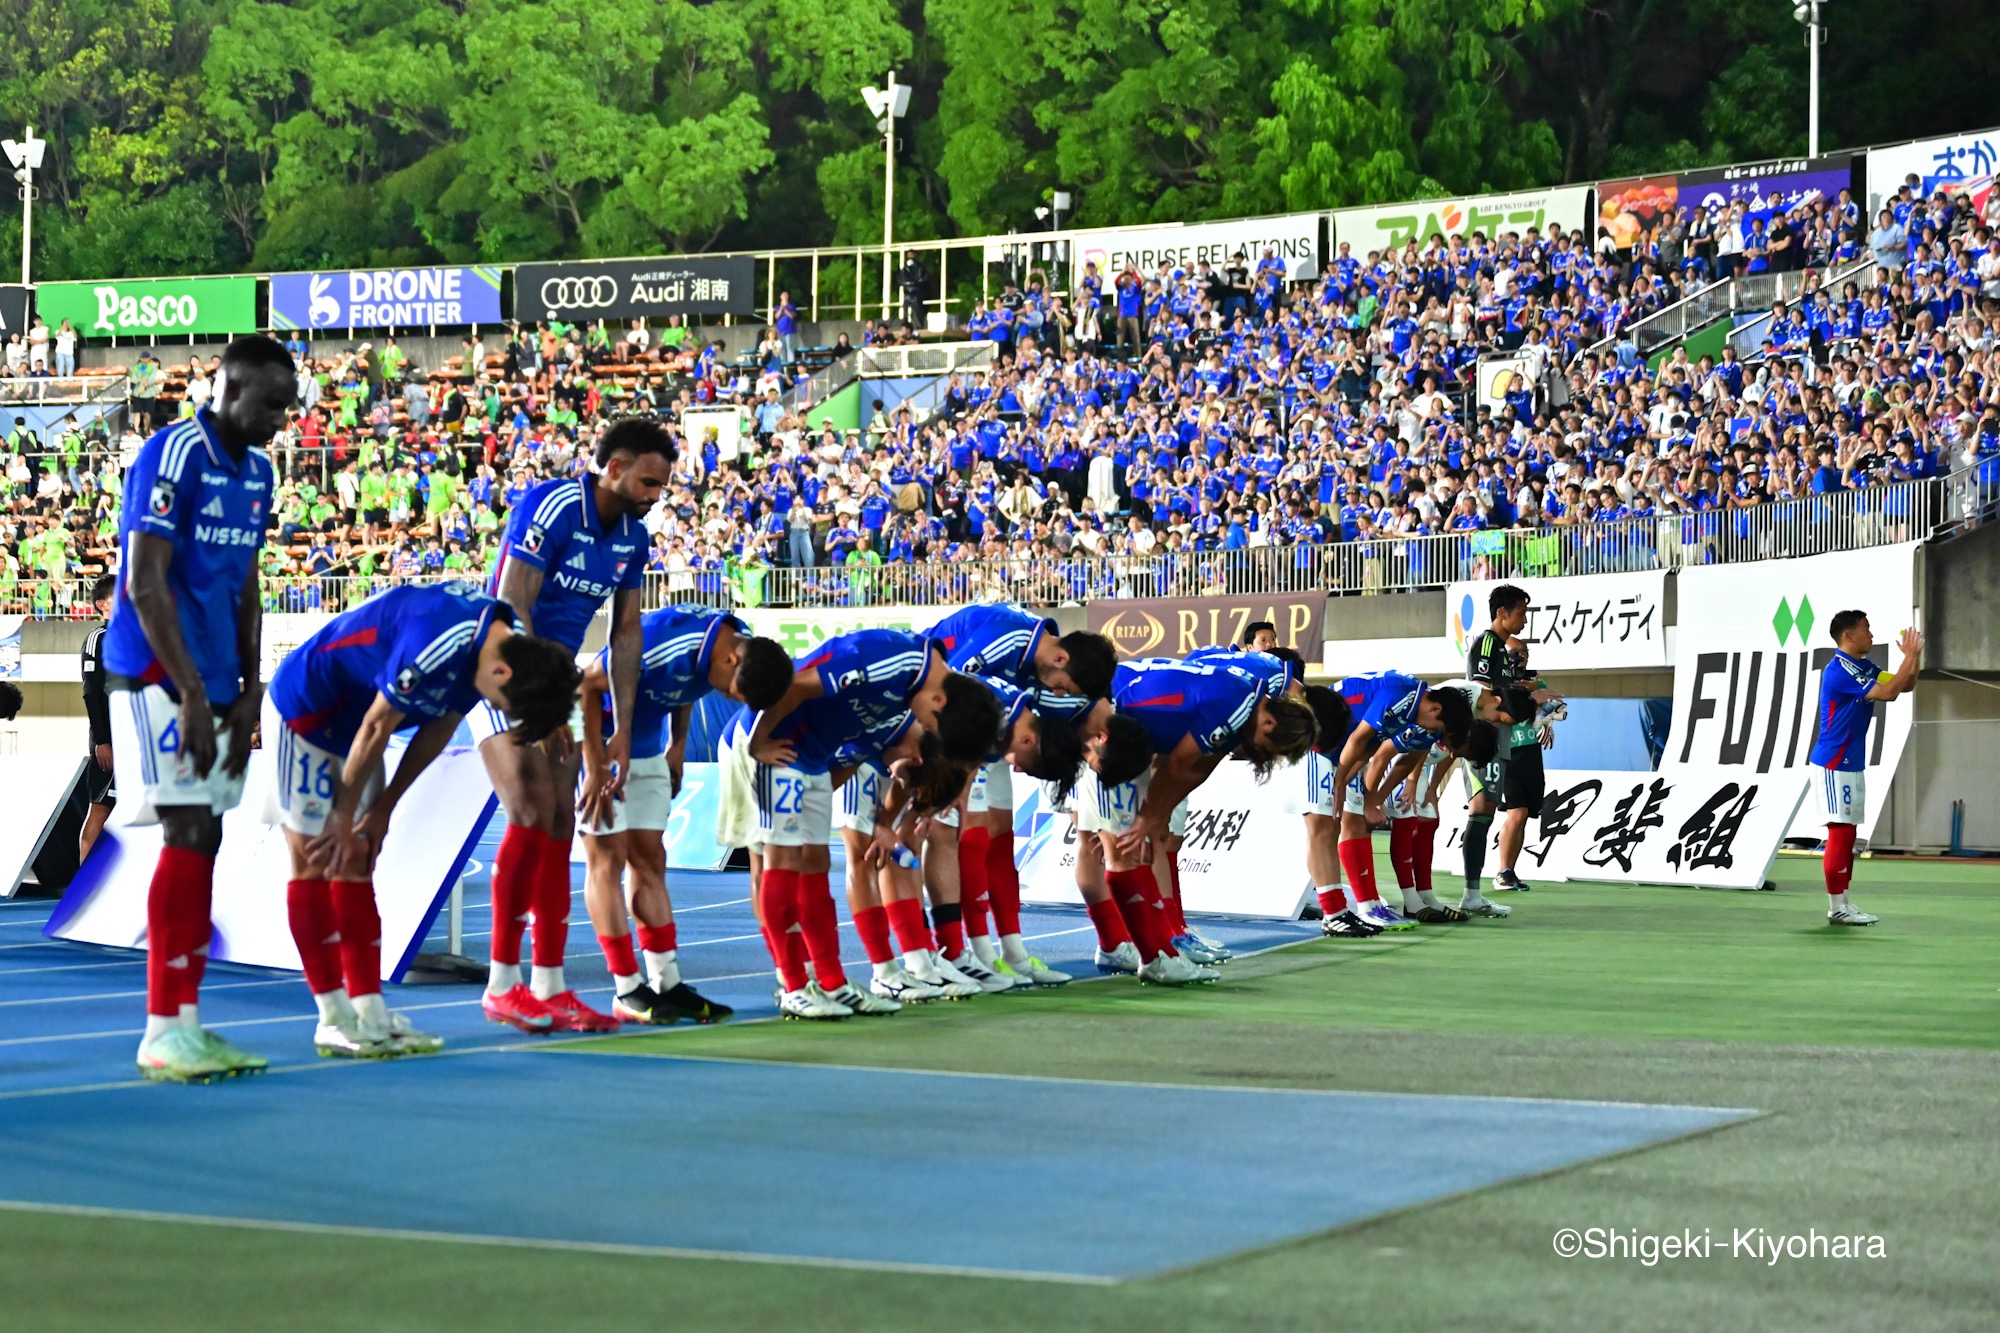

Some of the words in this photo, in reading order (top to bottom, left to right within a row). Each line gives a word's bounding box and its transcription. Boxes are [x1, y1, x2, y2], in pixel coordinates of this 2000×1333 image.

[1523, 198, 1547, 209] GROUP
[1111, 247, 1191, 273] ENRISE
[349, 268, 462, 303] DRONE
[630, 281, 685, 304] Audi
[690, 278, 730, 301] 湘南
[93, 286, 198, 331] Pasco
[349, 302, 462, 327] FRONTIER
[552, 571, 617, 598] NISSA
[1116, 625, 1150, 639] RIZAP
[298, 752, 334, 799] 16
[1485, 762, 1500, 783] 19
[775, 777, 805, 814] 28
[1114, 781, 1137, 812] 17
[1842, 785, 1852, 805] 8
[1177, 857, 1212, 874] Clinic
